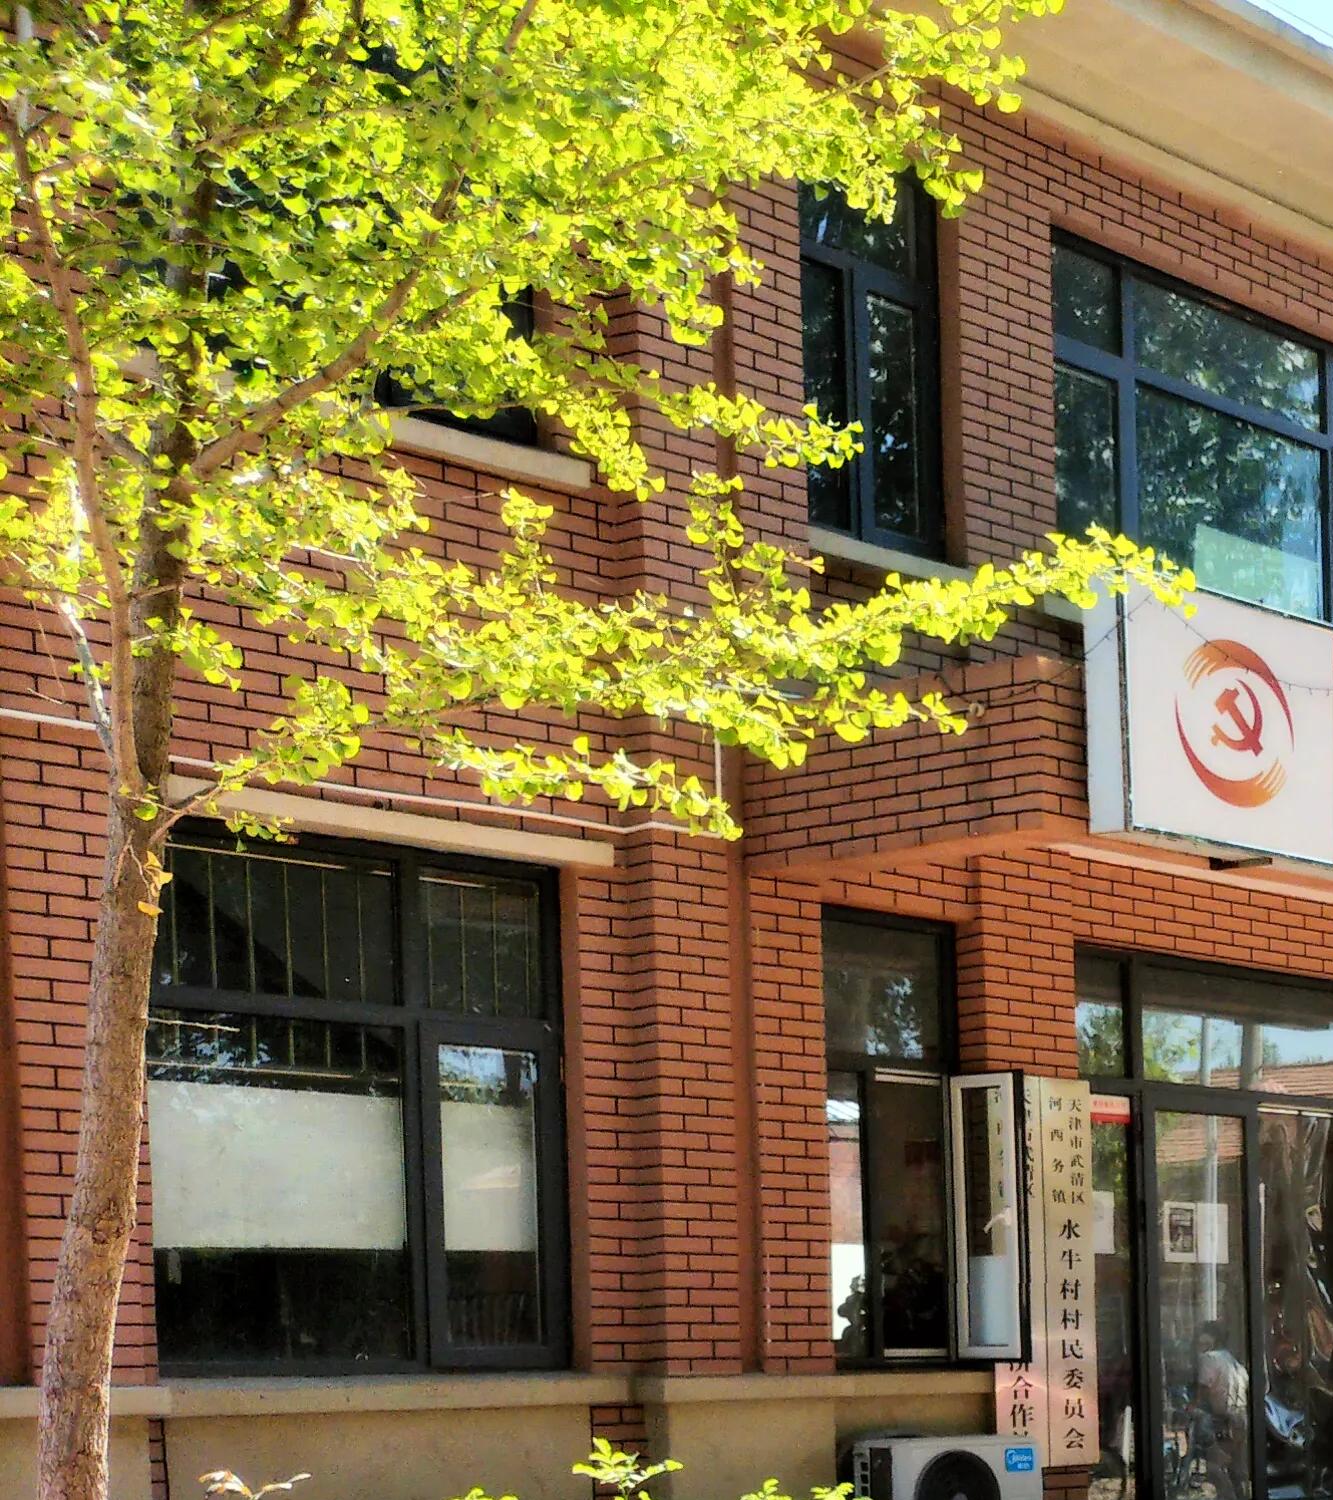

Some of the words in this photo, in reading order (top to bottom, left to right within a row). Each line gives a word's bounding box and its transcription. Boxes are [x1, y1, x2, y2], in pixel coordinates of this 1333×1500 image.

[1049, 1096, 1066, 1204] 河西务镇
[1069, 1097, 1085, 1205] 天津市武清区
[1059, 1218, 1084, 1450] 水牛村村民委员会
[1009, 1363, 1034, 1438] 合作
